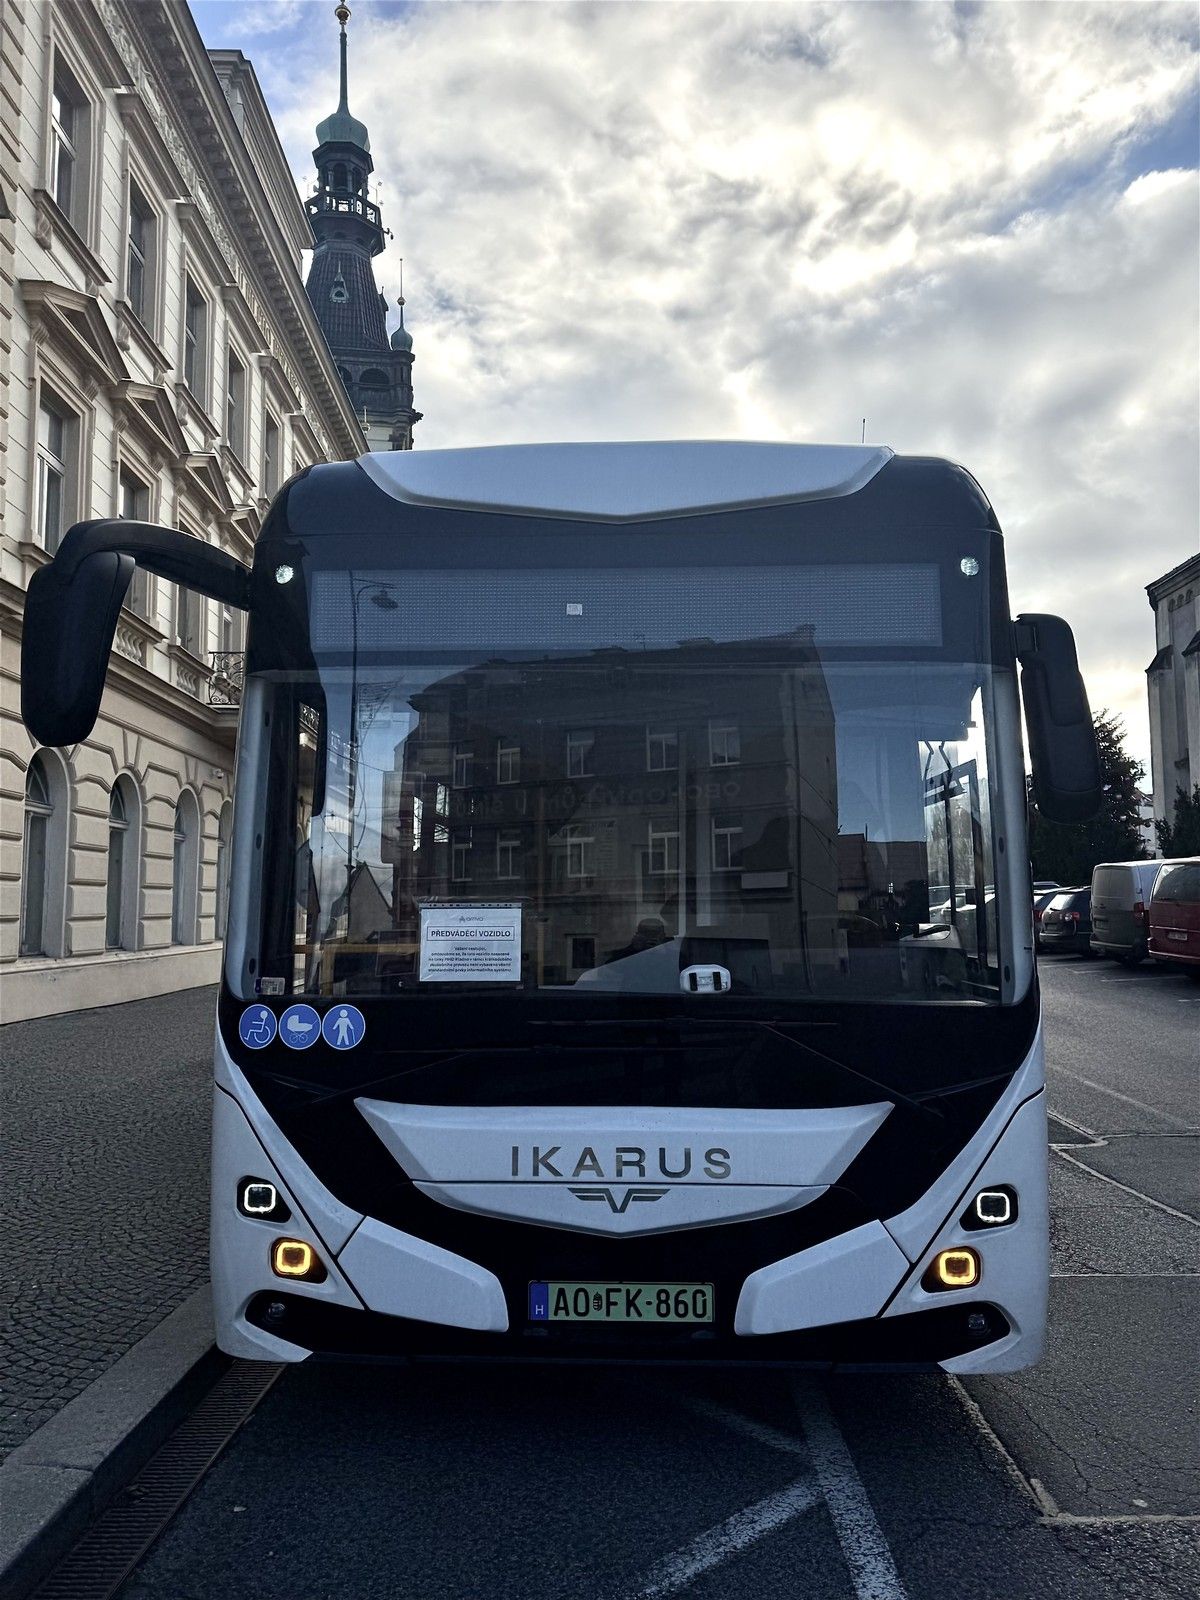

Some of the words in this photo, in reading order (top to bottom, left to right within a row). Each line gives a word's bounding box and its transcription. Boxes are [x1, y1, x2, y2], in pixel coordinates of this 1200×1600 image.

[431, 928, 478, 938] PŘEDVÁDĚCÍ
[478, 930, 511, 938] VOZIDLO
[512, 1146, 732, 1179] IKARUS
[535, 1305, 544, 1315] H
[605, 1288, 708, 1319] FK-860
